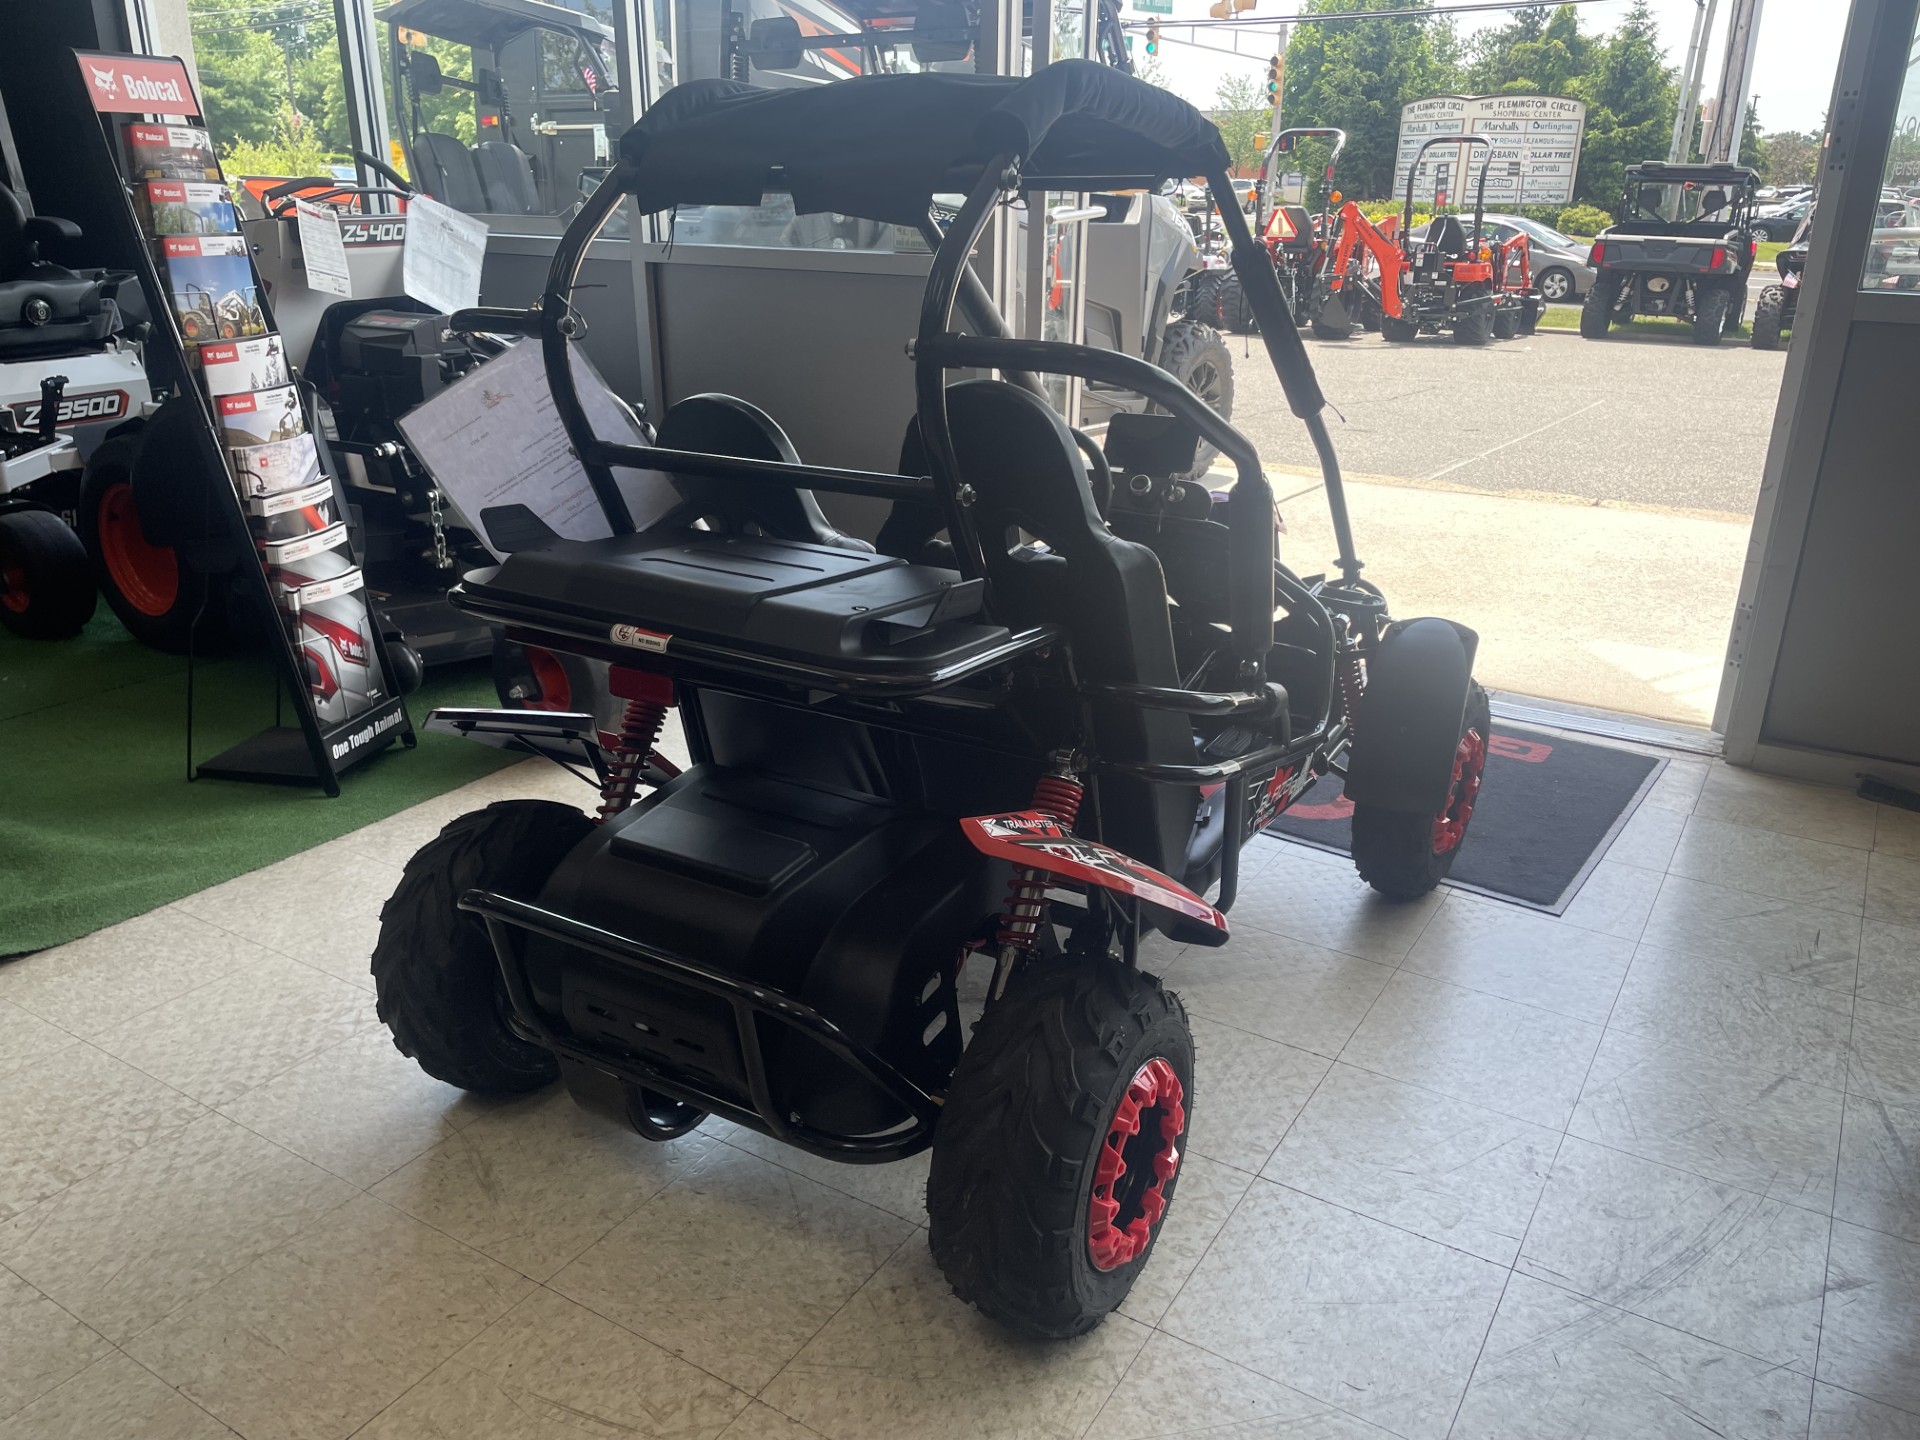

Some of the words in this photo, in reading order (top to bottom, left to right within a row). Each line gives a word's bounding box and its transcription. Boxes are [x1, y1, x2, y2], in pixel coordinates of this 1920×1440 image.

[122, 75, 184, 102] Bobcat
[1407, 105, 1415, 114] THE
[1417, 102, 1446, 112] FLEMINGTON
[1447, 102, 1465, 111] CIRCLE
[1480, 102, 1494, 111] THE
[1498, 100, 1547, 109] FLEMINGTON
[1551, 101, 1577, 112] CIRCLE
[1534, 110, 1562, 118] CENTER
[1481, 121, 1519, 131] Marshalls
[1533, 121, 1573, 132] Burlington
[1500, 137, 1522, 145] REHAB
[1473, 150, 1519, 159] DRESBARN
[1530, 151, 1552, 159] OLLAR
[1554, 151, 1572, 159] TREE
[1472, 178, 1512, 188] GmeStop
[23, 394, 120, 426] Z3500
[332, 741, 350, 760] One
[348, 725, 375, 750] Tough
[374, 707, 403, 735] Animal
[1002, 820, 1056, 829] TRAILMASTER
